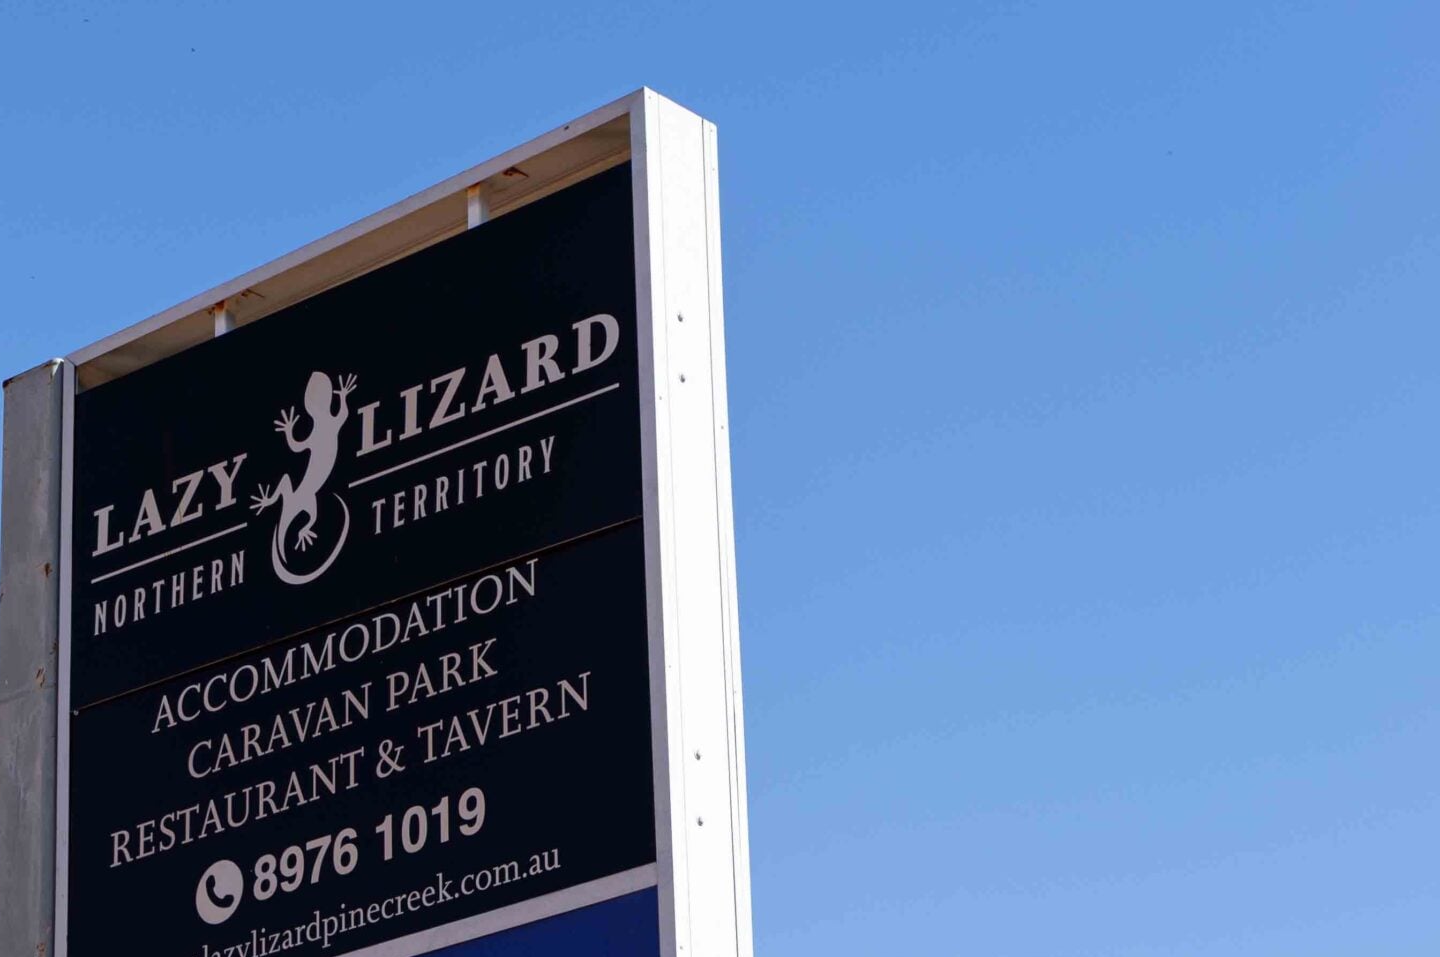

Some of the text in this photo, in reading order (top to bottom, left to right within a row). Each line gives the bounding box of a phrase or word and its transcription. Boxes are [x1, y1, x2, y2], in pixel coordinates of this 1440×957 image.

[92, 313, 620, 557] LAZY LIZARD
[93, 436, 556, 636] NORTHERN TERRITORY
[151, 558, 539, 733] ACCOMMODATION
[188, 638, 498, 779] CARAVAN PARK
[110, 671, 591, 868] RESTAURANT & TAVERN
[253, 787, 486, 901] 8976 1019
